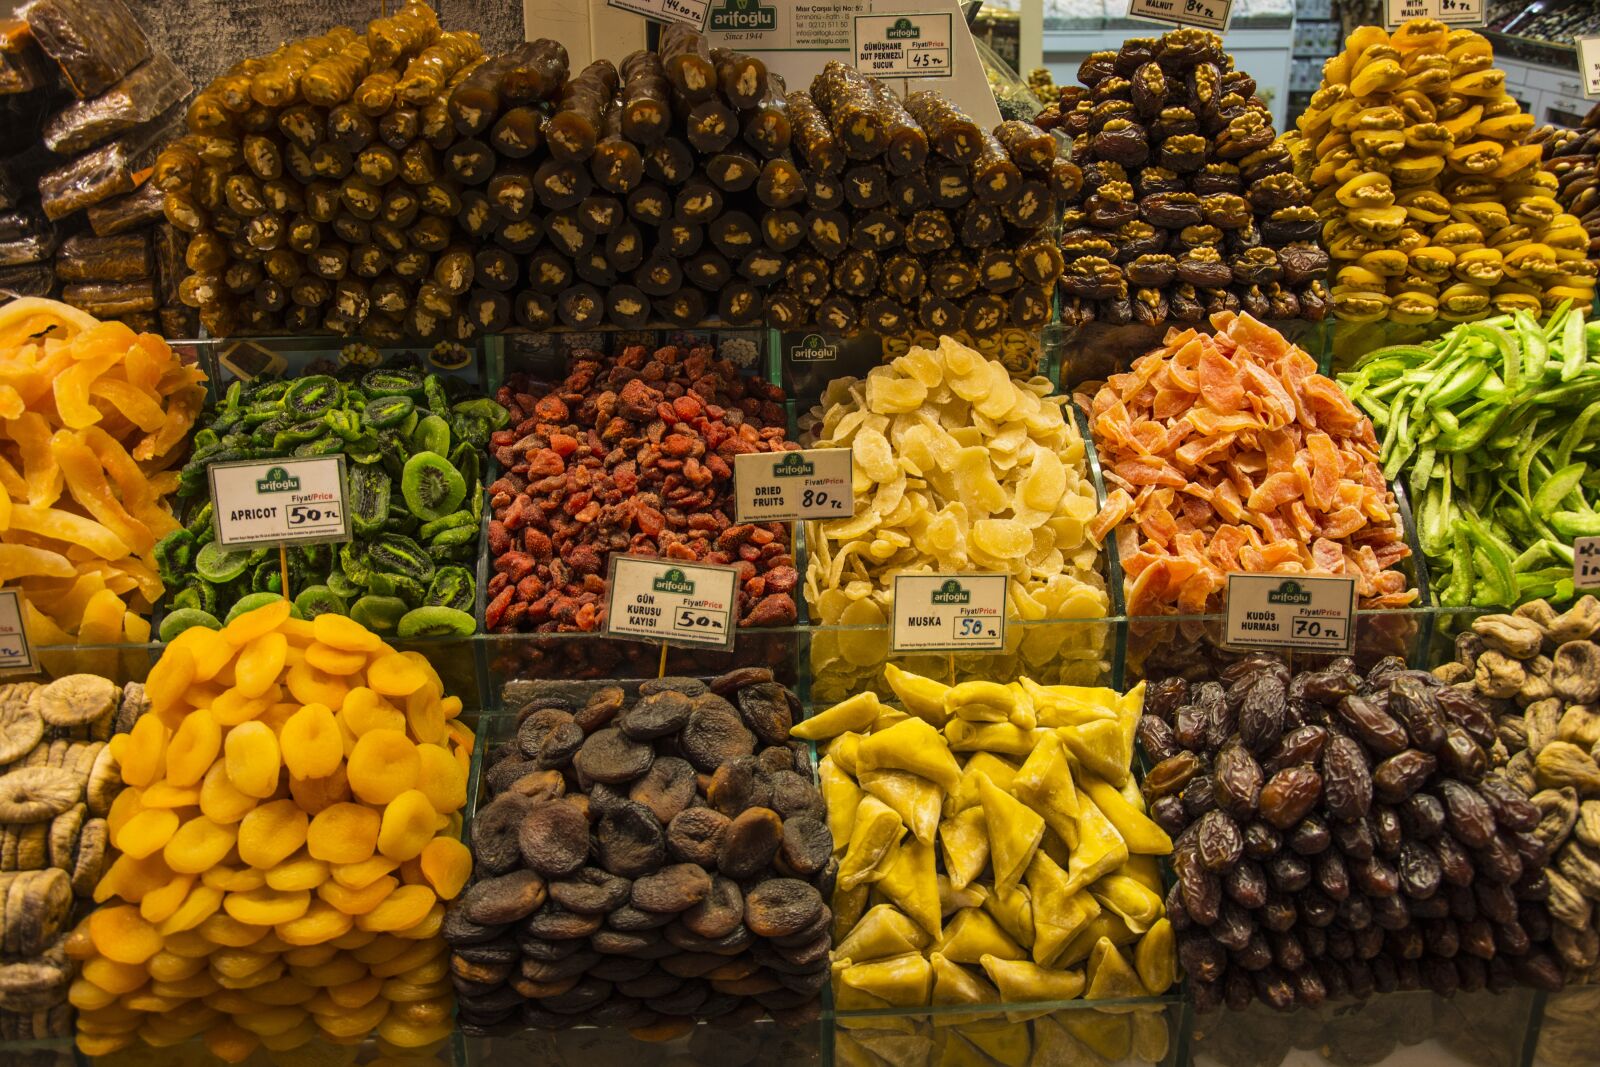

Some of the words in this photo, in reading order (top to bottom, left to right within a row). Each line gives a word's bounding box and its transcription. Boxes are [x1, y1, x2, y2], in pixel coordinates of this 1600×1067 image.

[1145, 0, 1174, 11] WALNUT
[1186, 0, 1204, 13] 84
[1401, 8, 1428, 17] WALNUT
[723, 32, 744, 41] Since
[745, 31, 763, 41] 1944
[863, 42, 902, 52] GÜMÜŞHANE
[912, 41, 944, 49] Fiyat/Price
[860, 52, 872, 60] DUT
[874, 50, 904, 60] PEKMEZLİ
[913, 54, 930, 67] 45
[872, 61, 894, 70] SUCUK
[755, 486, 782, 496] DRIED
[291, 493, 333, 503] Fiyat/Price
[753, 497, 784, 507] FRUITS
[802, 489, 828, 508] 80
[230, 507, 277, 521] APRICOT
[289, 506, 322, 524] 50
[636, 593, 655, 604] GÜN
[683, 598, 723, 609] Fiyat/Price
[627, 604, 662, 617] KURUSU
[960, 607, 997, 616] Fiyat/Price
[1246, 610, 1276, 621] KUDÜS
[1300, 608, 1341, 617] Fiyat/Price
[629, 616, 657, 627] KAYISI
[677, 611, 710, 627] 50
[908, 616, 942, 627] MUSKA
[959, 618, 983, 636] 50
[1241, 622, 1280, 632] HURMASI
[1295, 620, 1321, 637] 70
